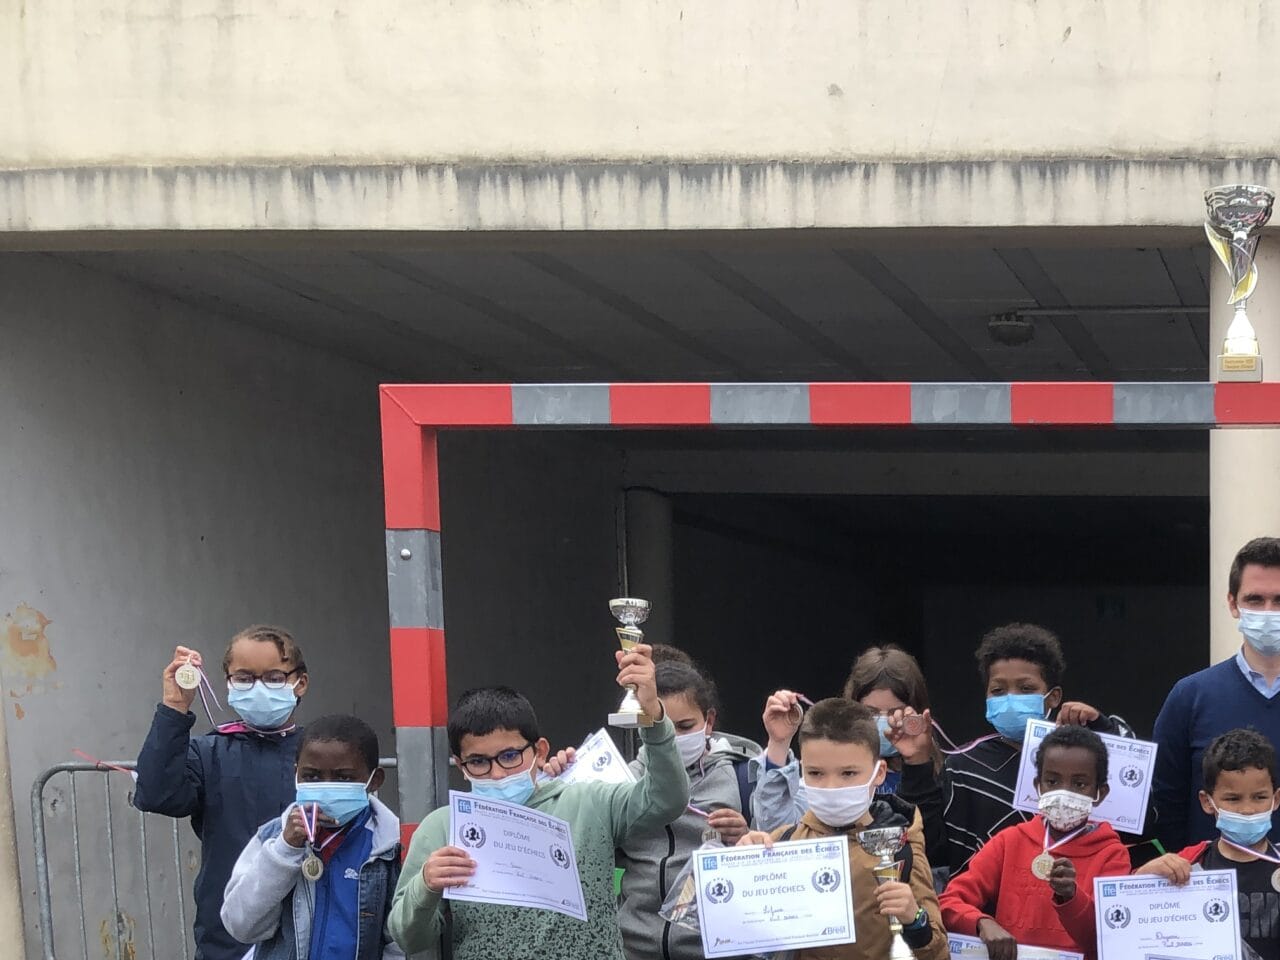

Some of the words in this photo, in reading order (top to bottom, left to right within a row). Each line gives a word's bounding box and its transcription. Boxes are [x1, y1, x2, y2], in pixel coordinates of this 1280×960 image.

[473, 801, 508, 815] FÉDÉRATION
[509, 809, 538, 825] FRANÇAISE
[503, 828, 531, 843] DIPLÔME
[493, 840, 504, 848] DU
[504, 843, 517, 852] JEU
[720, 853, 761, 863] FÉDÉRATION
[762, 848, 799, 860] FRANÇAISE
[815, 842, 841, 854] ÉCHECS
[703, 857, 717, 870] ffe
[753, 872, 788, 883] DIPLÔME
[1119, 881, 1156, 891] FÉDÉRATION
[1206, 876, 1230, 885] ÉCHECS
[742, 889, 754, 898] DU
[755, 887, 769, 897] JEU
[770, 884, 806, 895] D'ÉCHECS
[1103, 885, 1117, 897] ffe
[1149, 901, 1181, 911] DIPLÔME
[1149, 916, 1163, 924] JEU
[1164, 914, 1197, 923] D'ÉCHECS
